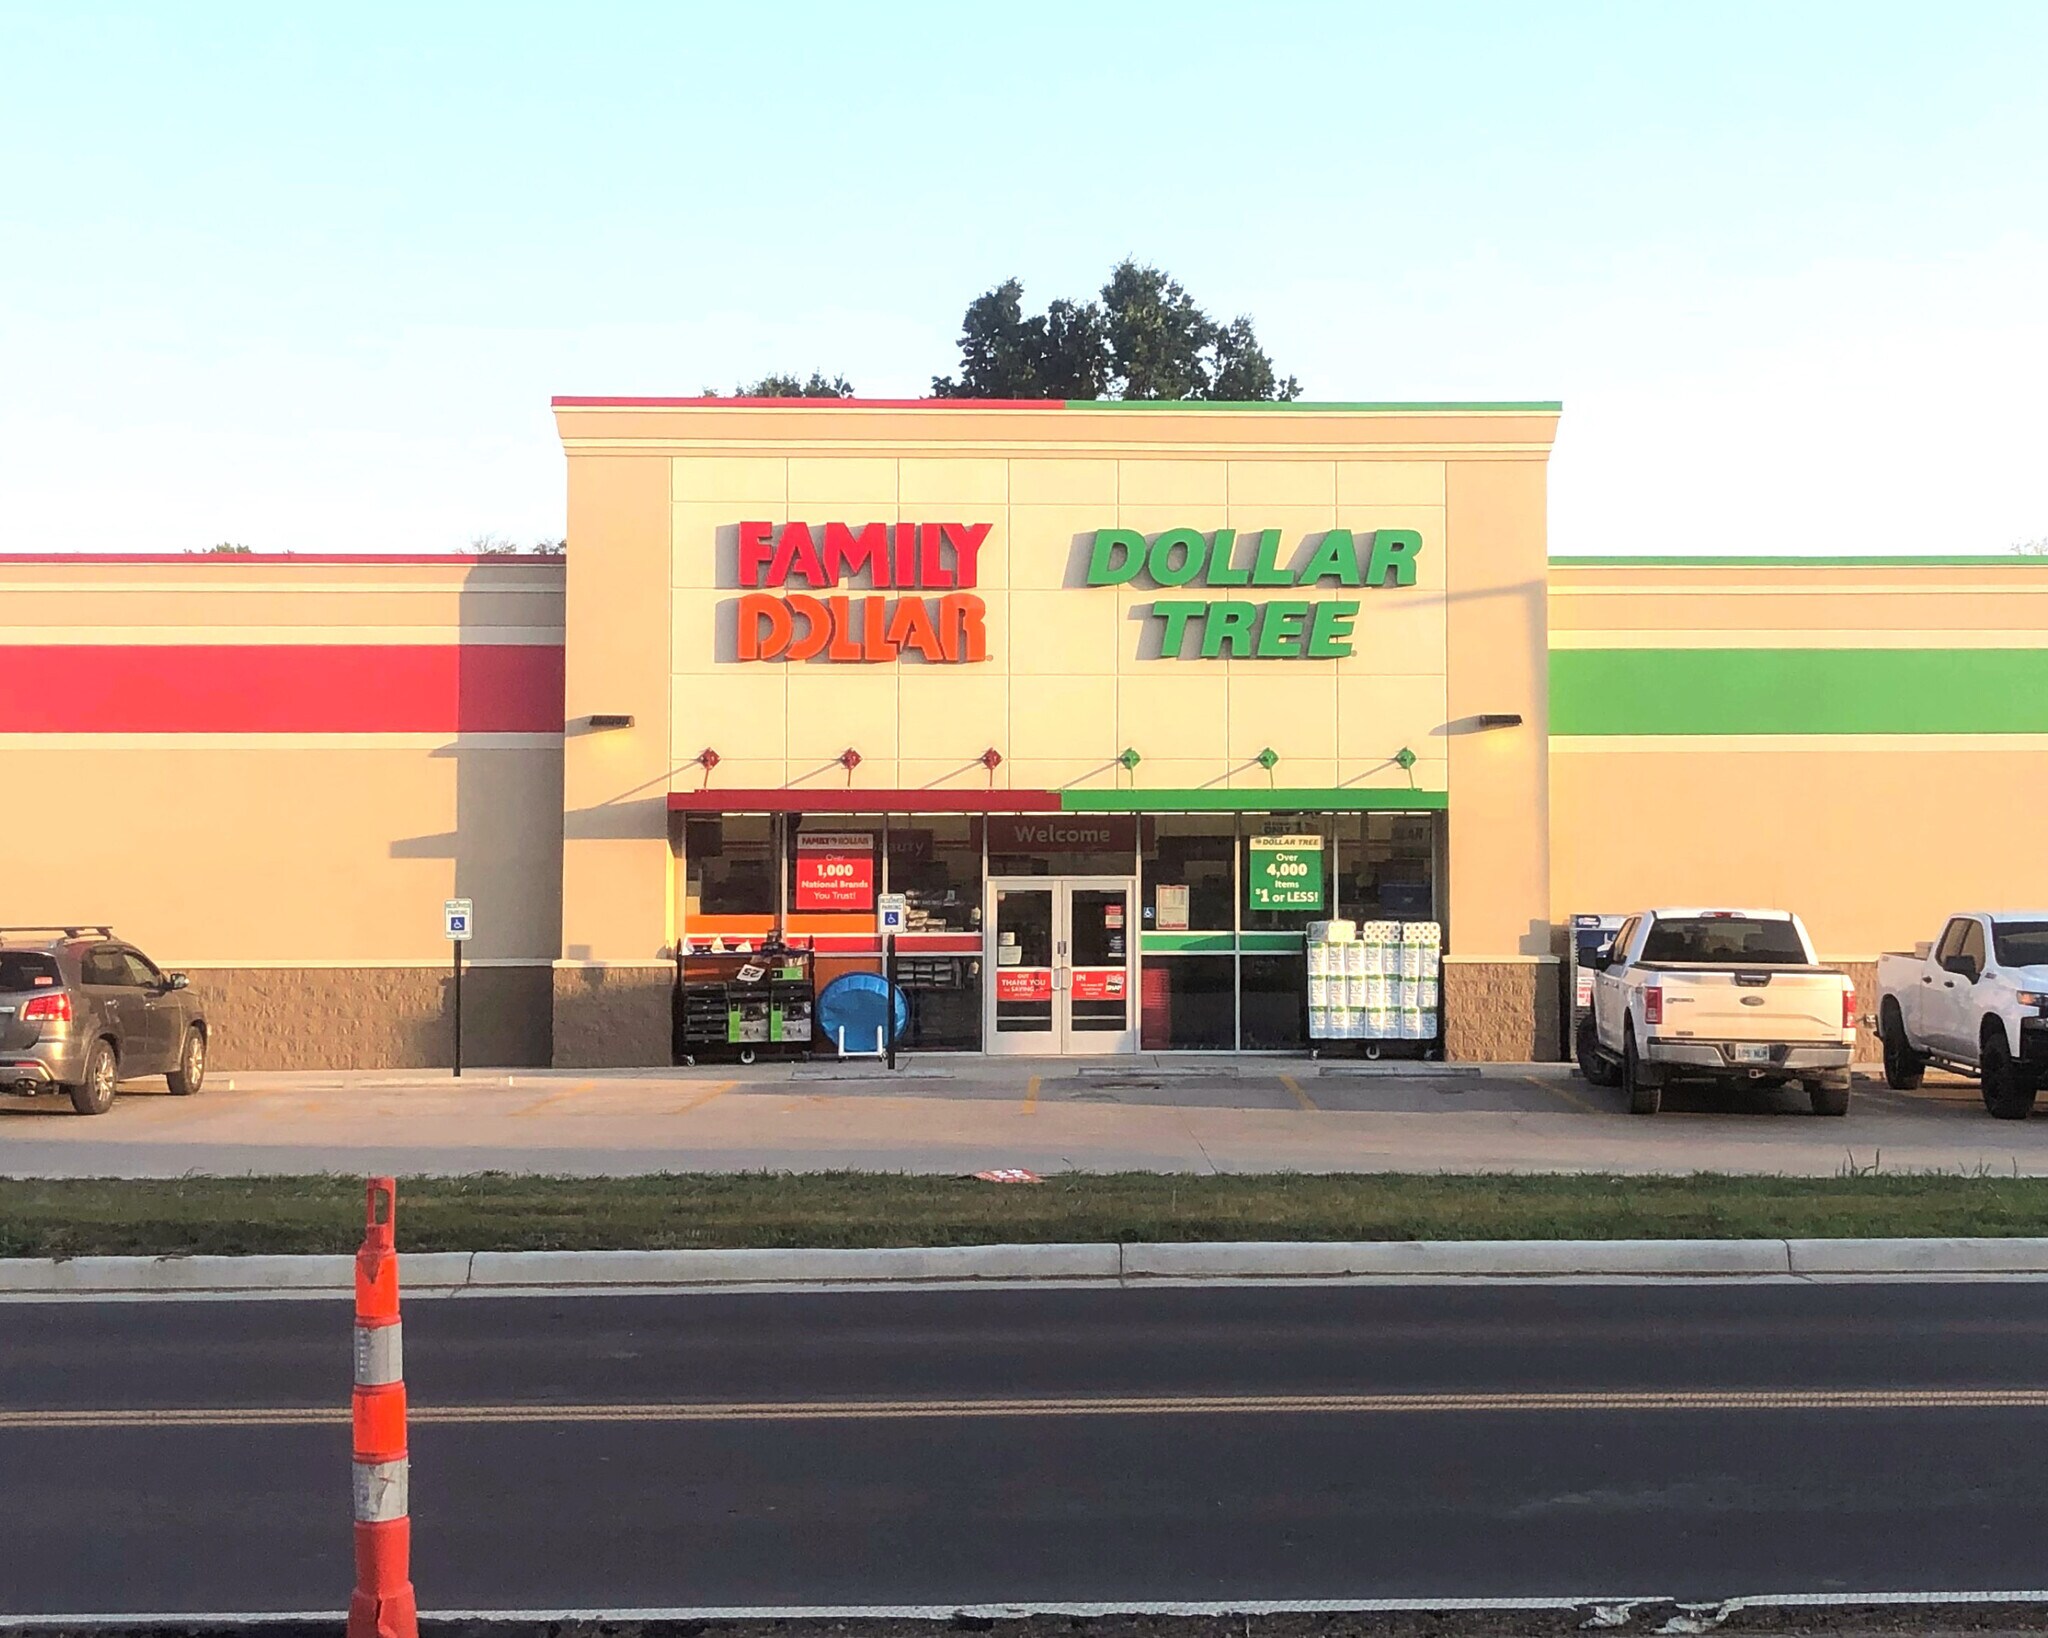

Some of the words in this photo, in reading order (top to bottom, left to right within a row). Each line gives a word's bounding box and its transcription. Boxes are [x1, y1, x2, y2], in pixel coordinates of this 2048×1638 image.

[737, 521, 993, 588] FAMILY
[1087, 528, 1423, 586] DOLLAR
[737, 593, 986, 662] DOLLAR
[1152, 601, 1360, 658] TREE
[1014, 824, 1111, 843] Welcome
[1276, 853, 1298, 862] Over
[817, 864, 853, 878] 1,000
[1266, 863, 1308, 878] 4,000
[801, 880, 838, 888] National
[839, 880, 869, 888] Brands
[1275, 880, 1300, 889] Items
[814, 891, 830, 900] You
[832, 891, 856, 900] Trust!
[1272, 894, 1285, 903] or
[1287, 891, 1319, 903] LESS!
[1076, 974, 1087, 982] IN
